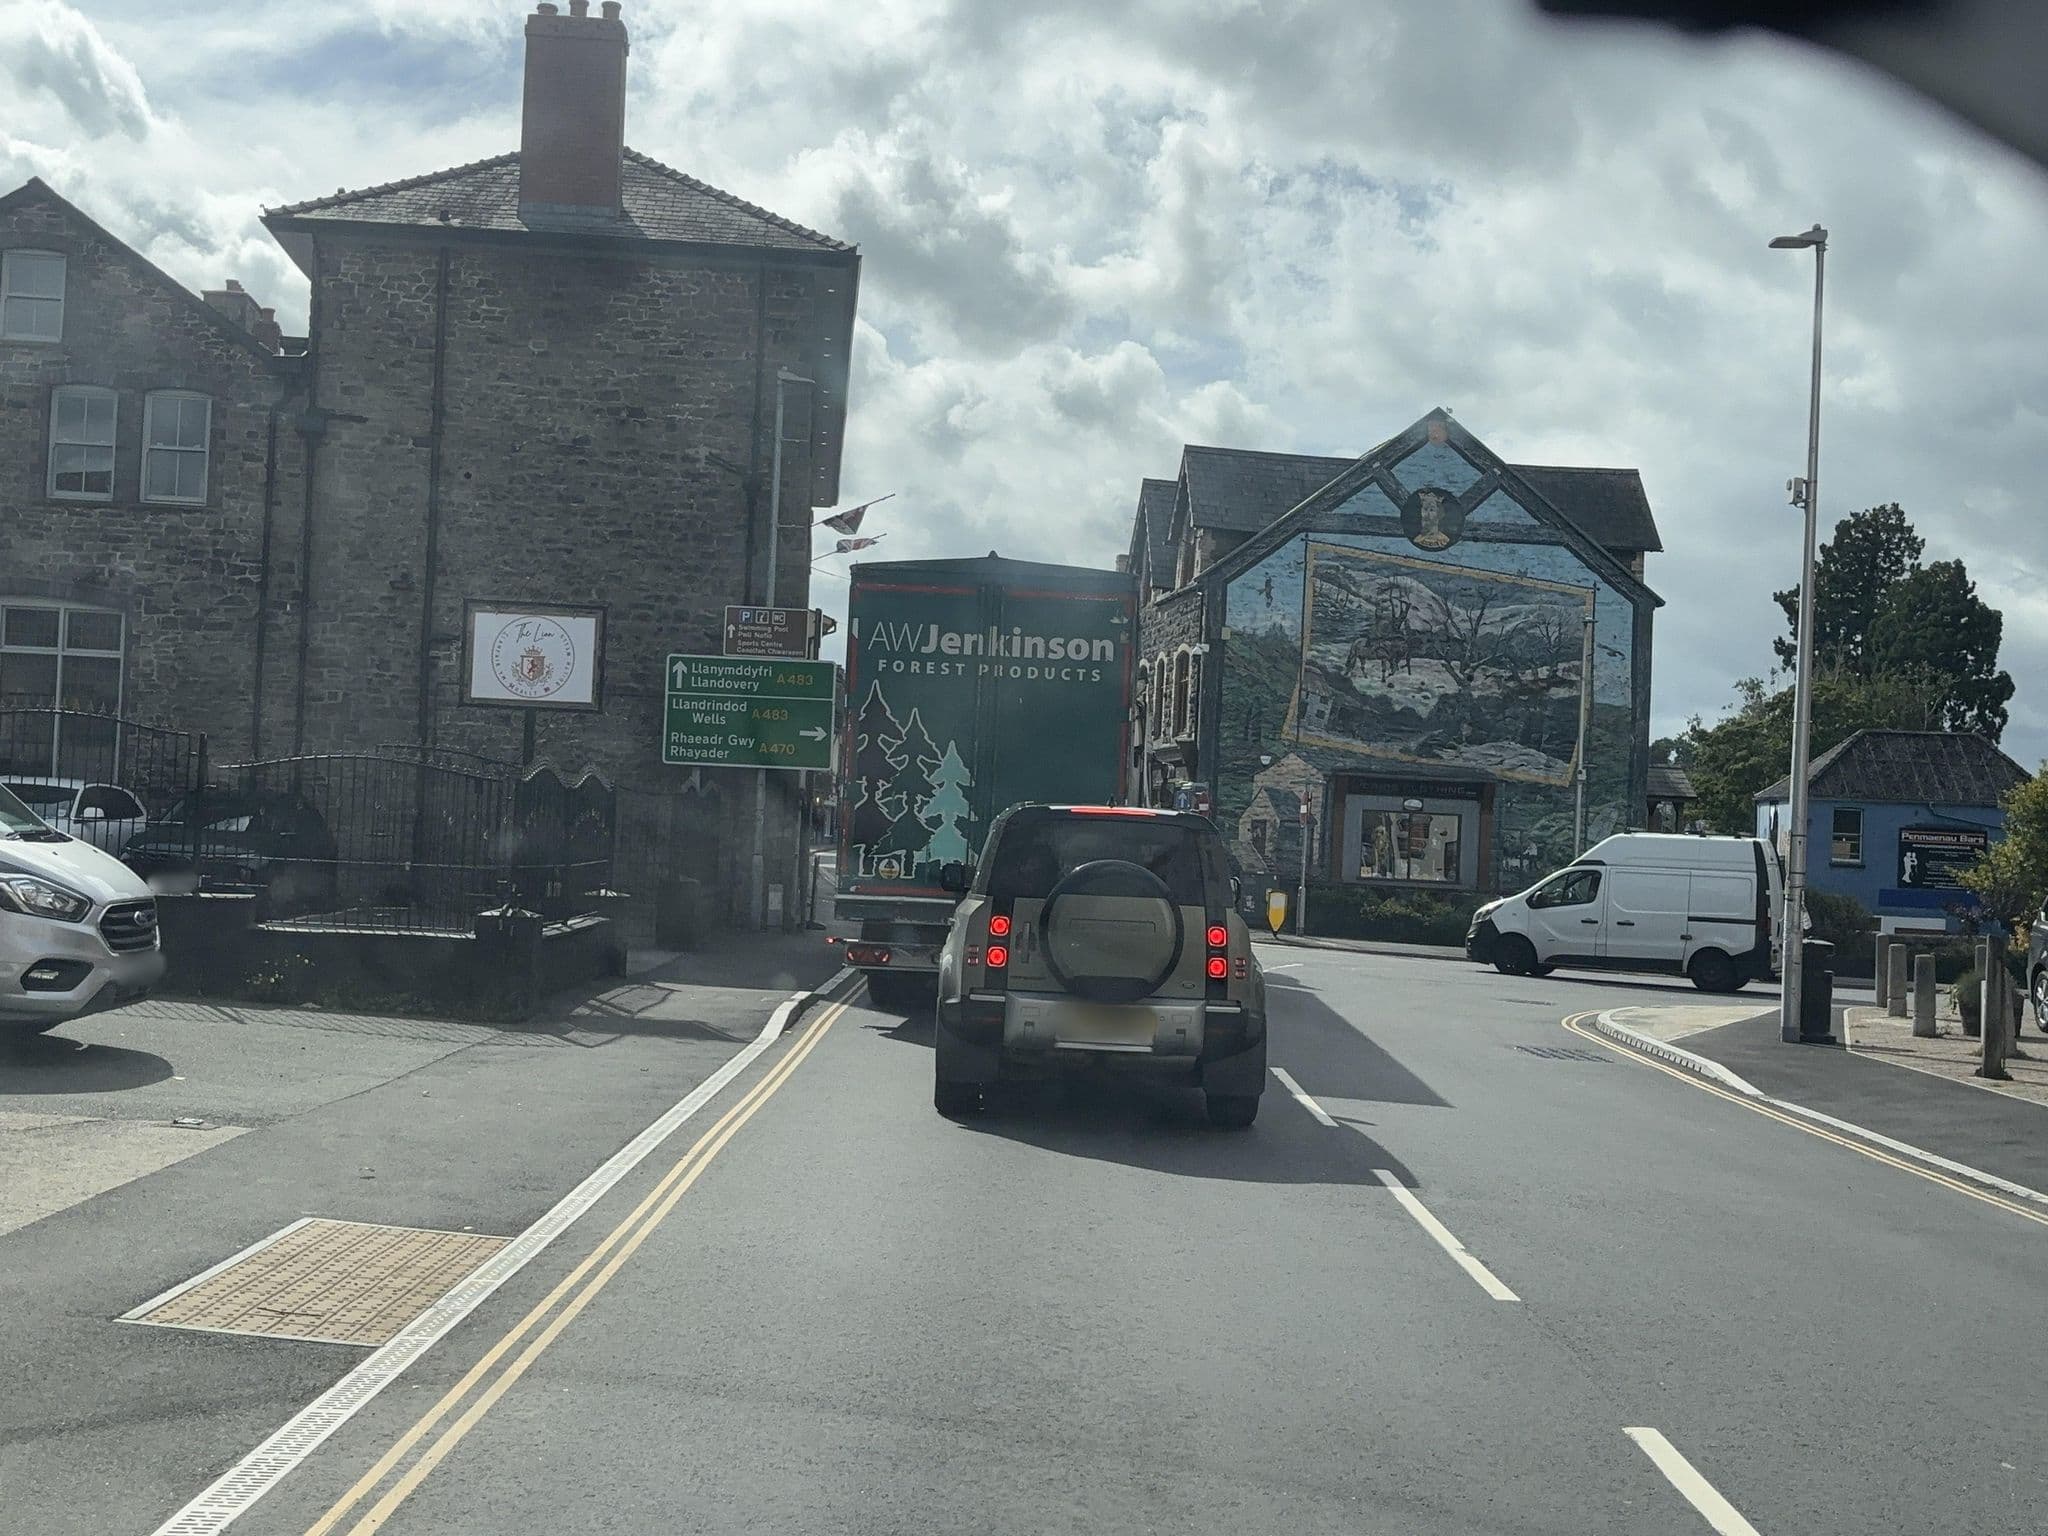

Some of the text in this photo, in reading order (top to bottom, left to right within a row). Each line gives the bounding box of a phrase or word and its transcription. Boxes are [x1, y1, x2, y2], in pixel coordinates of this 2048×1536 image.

[742, 611, 750, 621] P
[515, 621, 555, 643] The Lion
[691, 663, 773, 678] Llanymddyfri
[878, 659, 1102, 682] FOREST PRODUCTS
[691, 676, 760, 692] Llandovery
[776, 674, 813, 686] A483
[672, 698, 748, 712] Llandrindod
[693, 713, 726, 725] Wells
[752, 709, 789, 721] A483
[671, 732, 755, 748] Rhaeadr Gwy
[670, 746, 730, 760] Rhayader
[759, 743, 796, 754] A470
[1960, 835, 1985, 843] Bars
